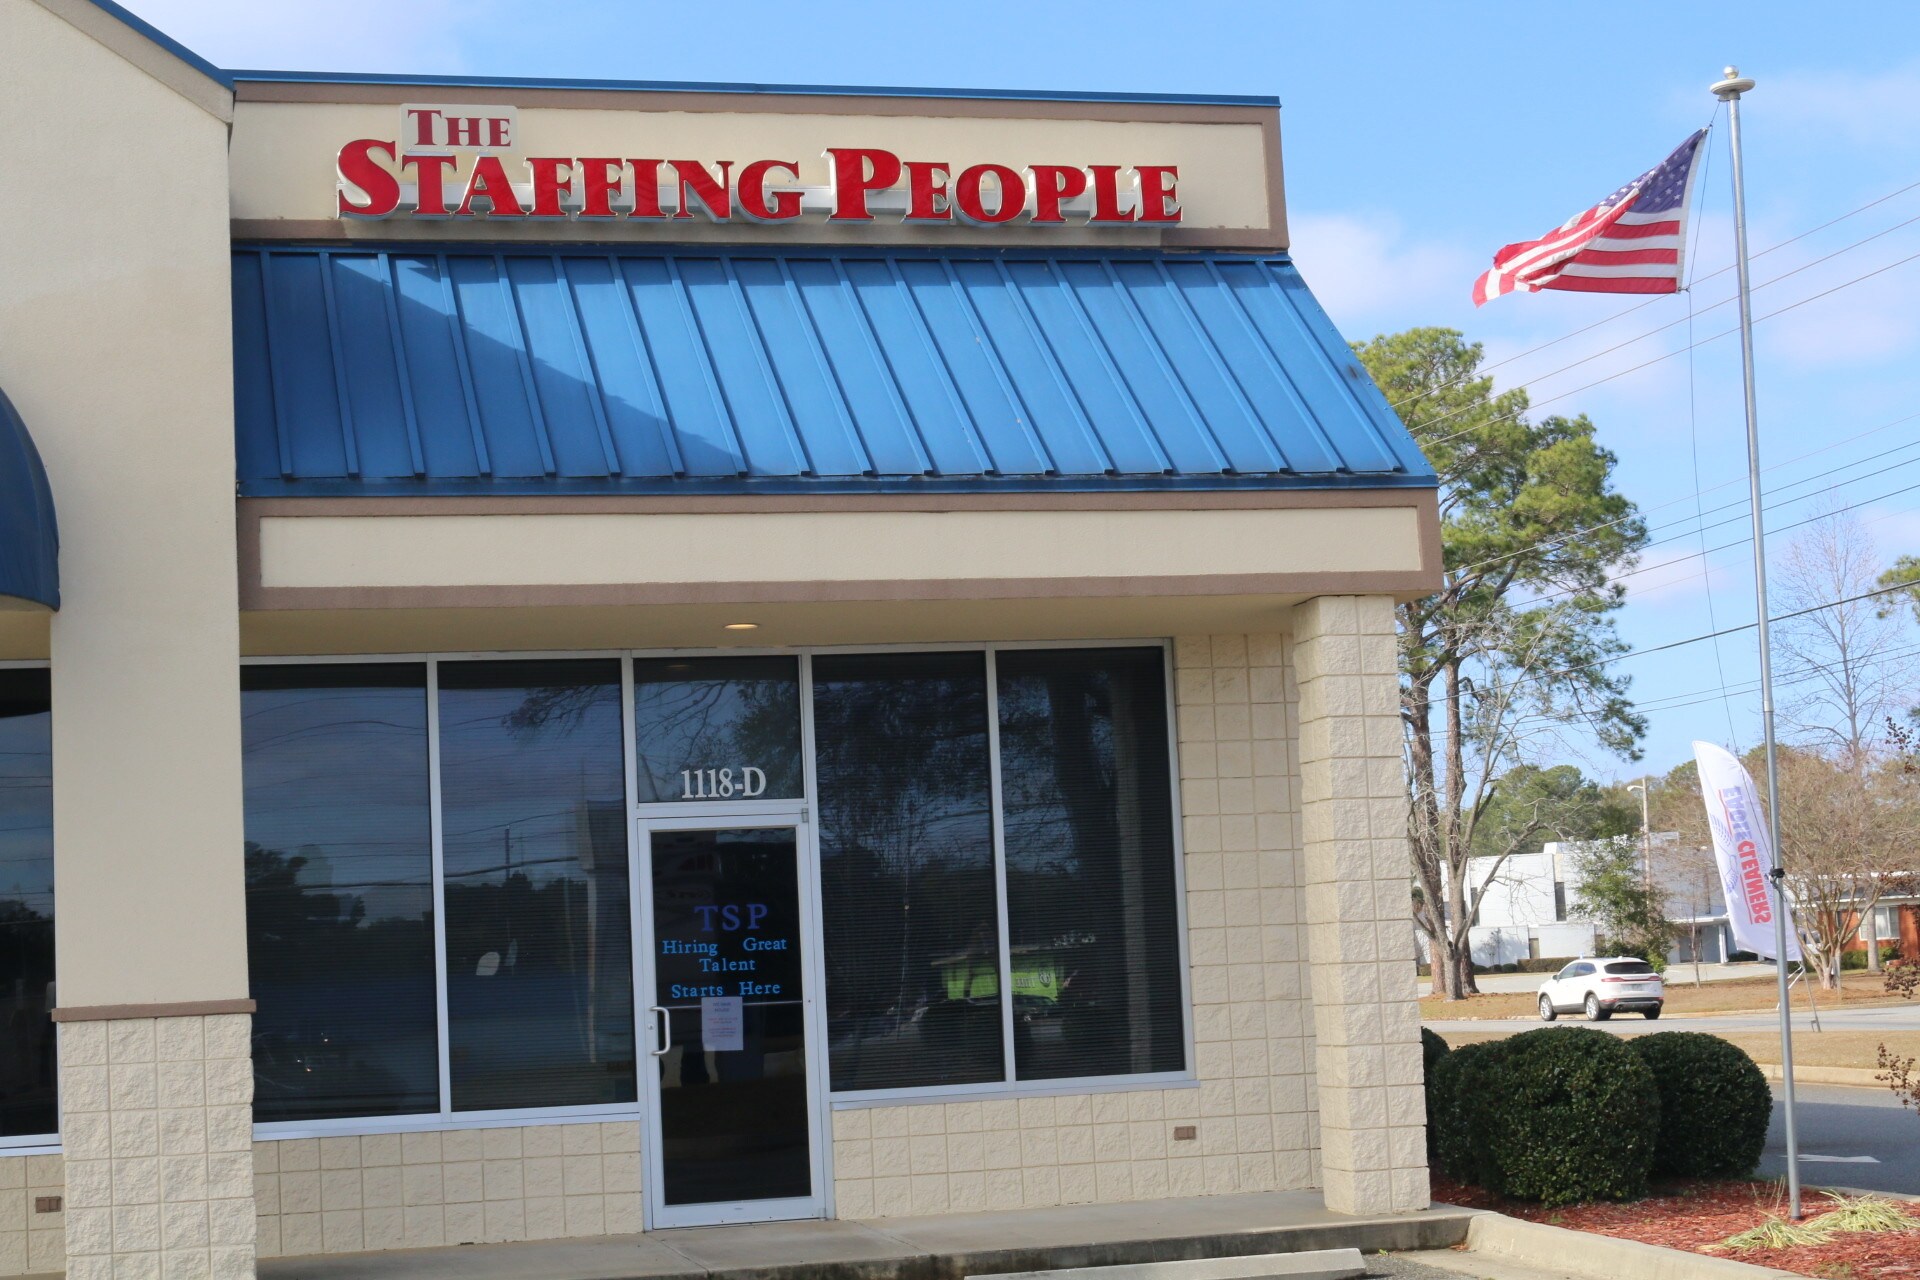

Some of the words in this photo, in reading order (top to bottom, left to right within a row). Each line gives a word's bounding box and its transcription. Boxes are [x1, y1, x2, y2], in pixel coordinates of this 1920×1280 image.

[407, 109, 512, 147] THE
[337, 139, 804, 220] STAFFING
[822, 148, 1182, 223] PEOPLE
[681, 766, 767, 799] 1118-D
[694, 903, 768, 932] TSP
[662, 940, 719, 957] Hiring
[743, 937, 787, 952] Great
[699, 957, 756, 972] Talent
[671, 984, 723, 999] Starts
[739, 981, 781, 996] Here
